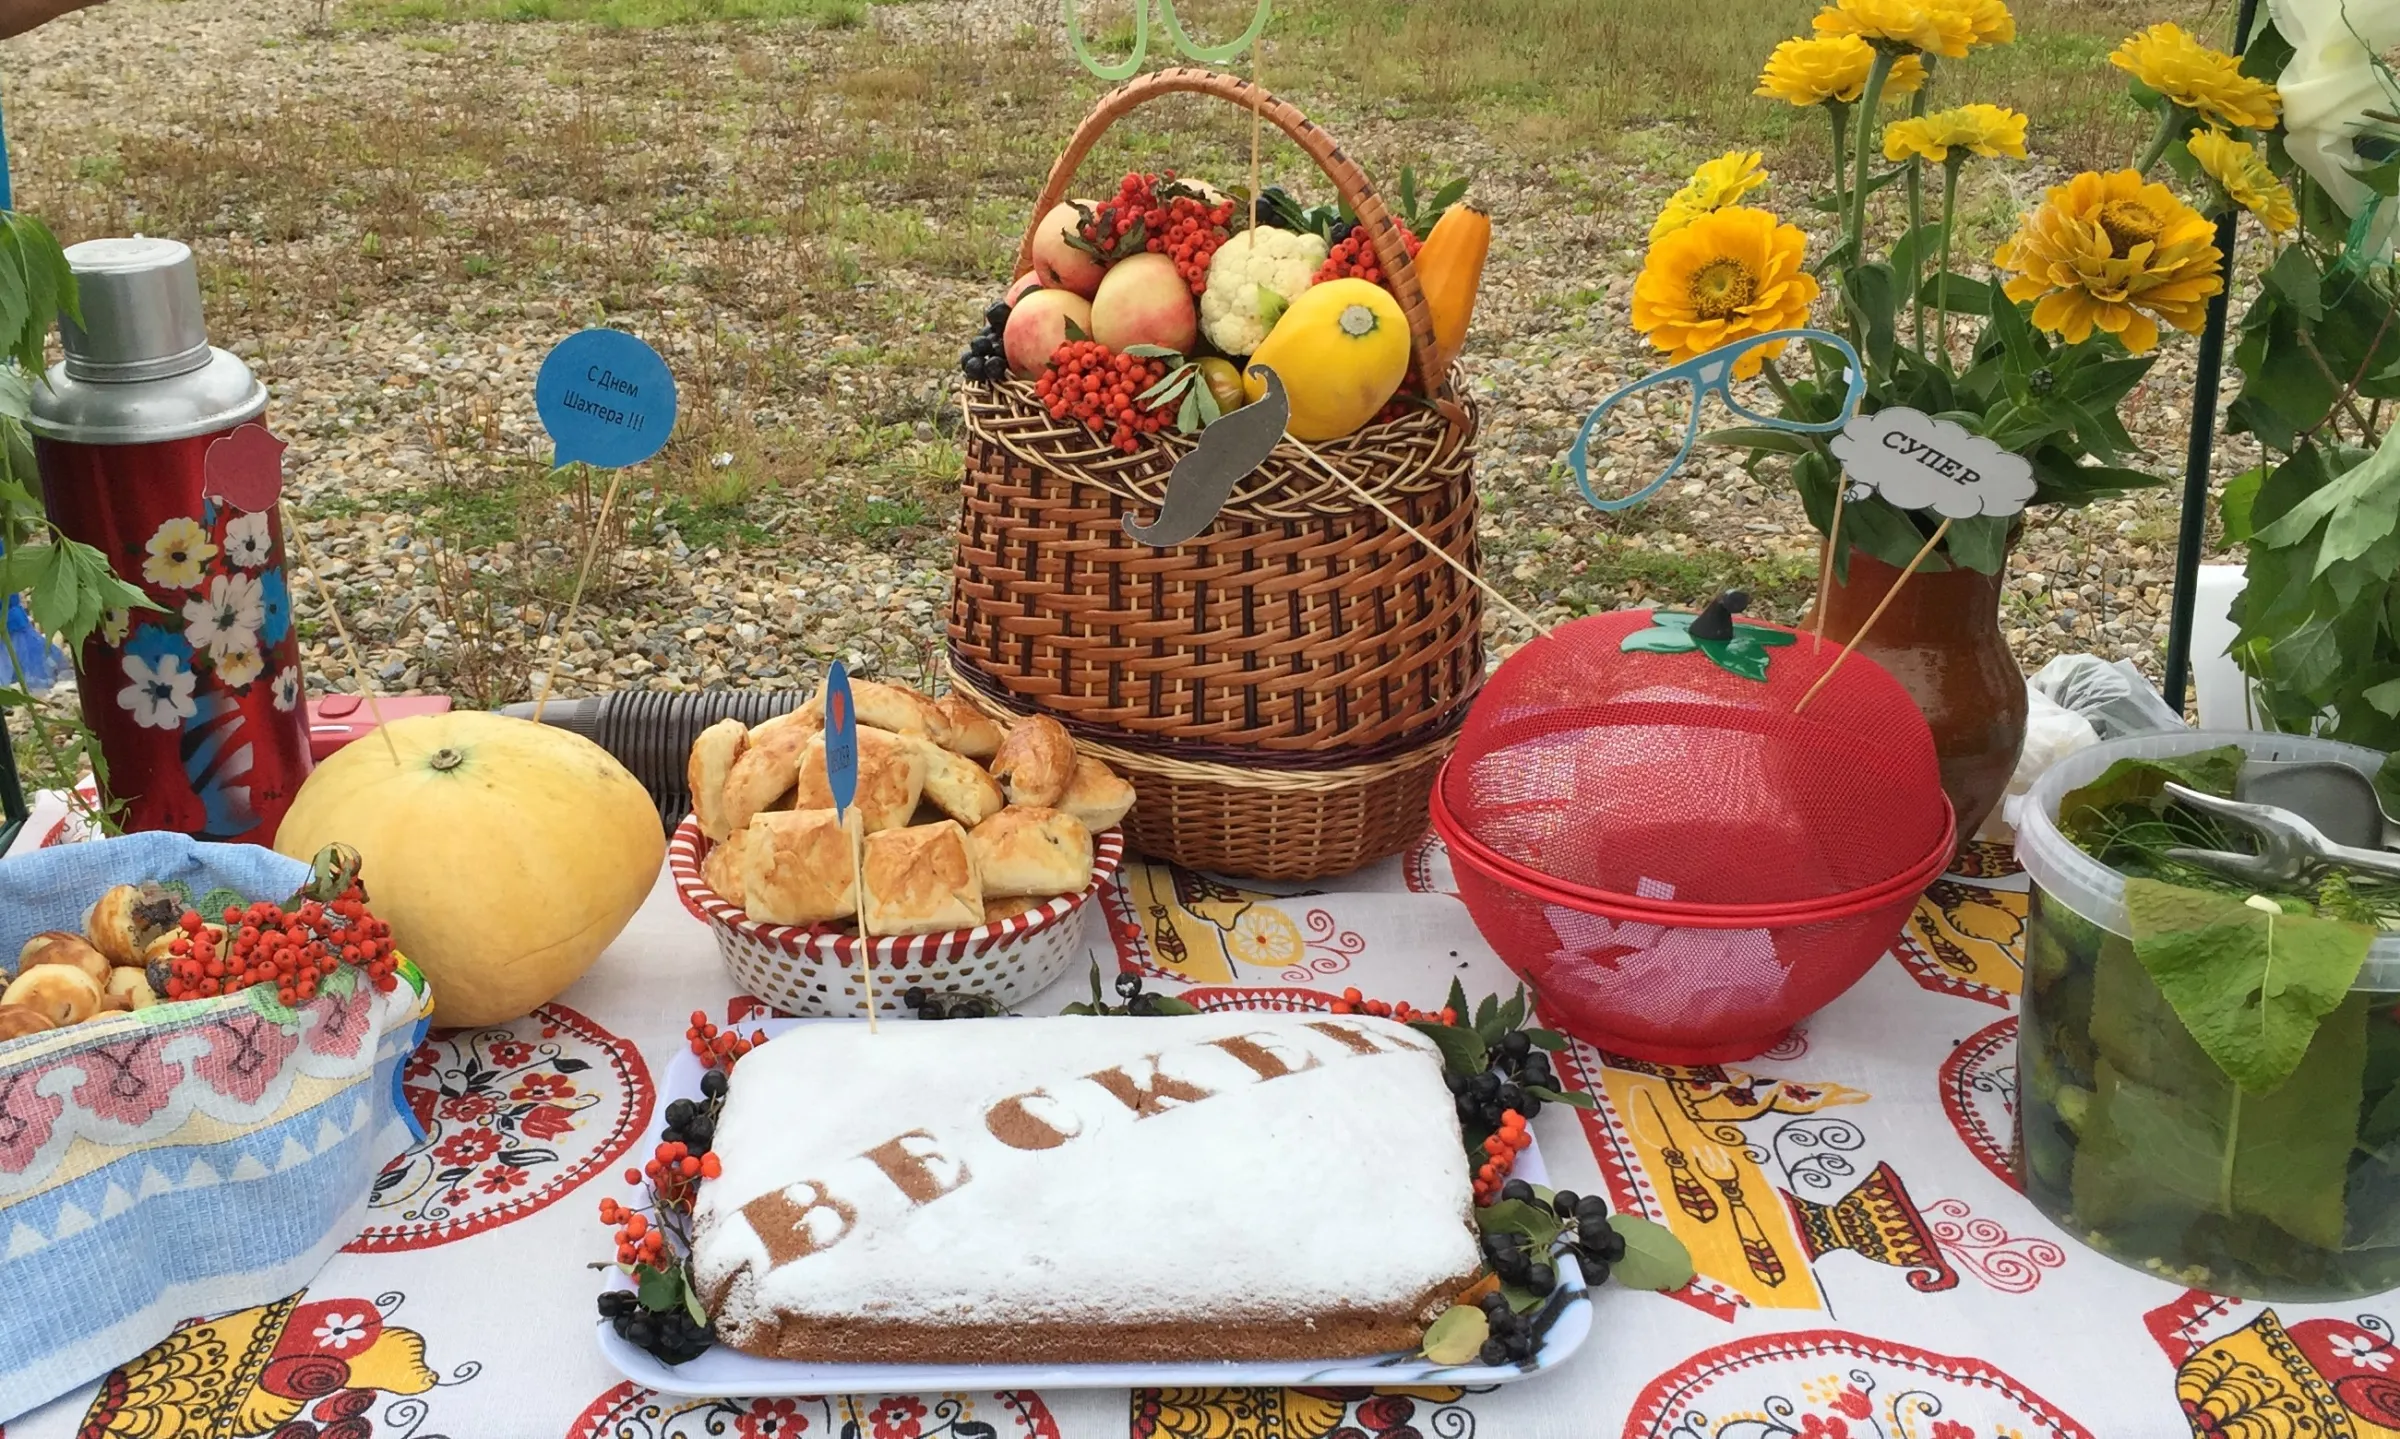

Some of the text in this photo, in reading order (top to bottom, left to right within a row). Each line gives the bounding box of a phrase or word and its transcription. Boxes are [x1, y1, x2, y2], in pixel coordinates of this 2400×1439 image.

[587, 365, 639, 398] С Днем
[563, 389, 624, 425] Шахтера
[1882, 431, 1981, 486] СУПЕР
